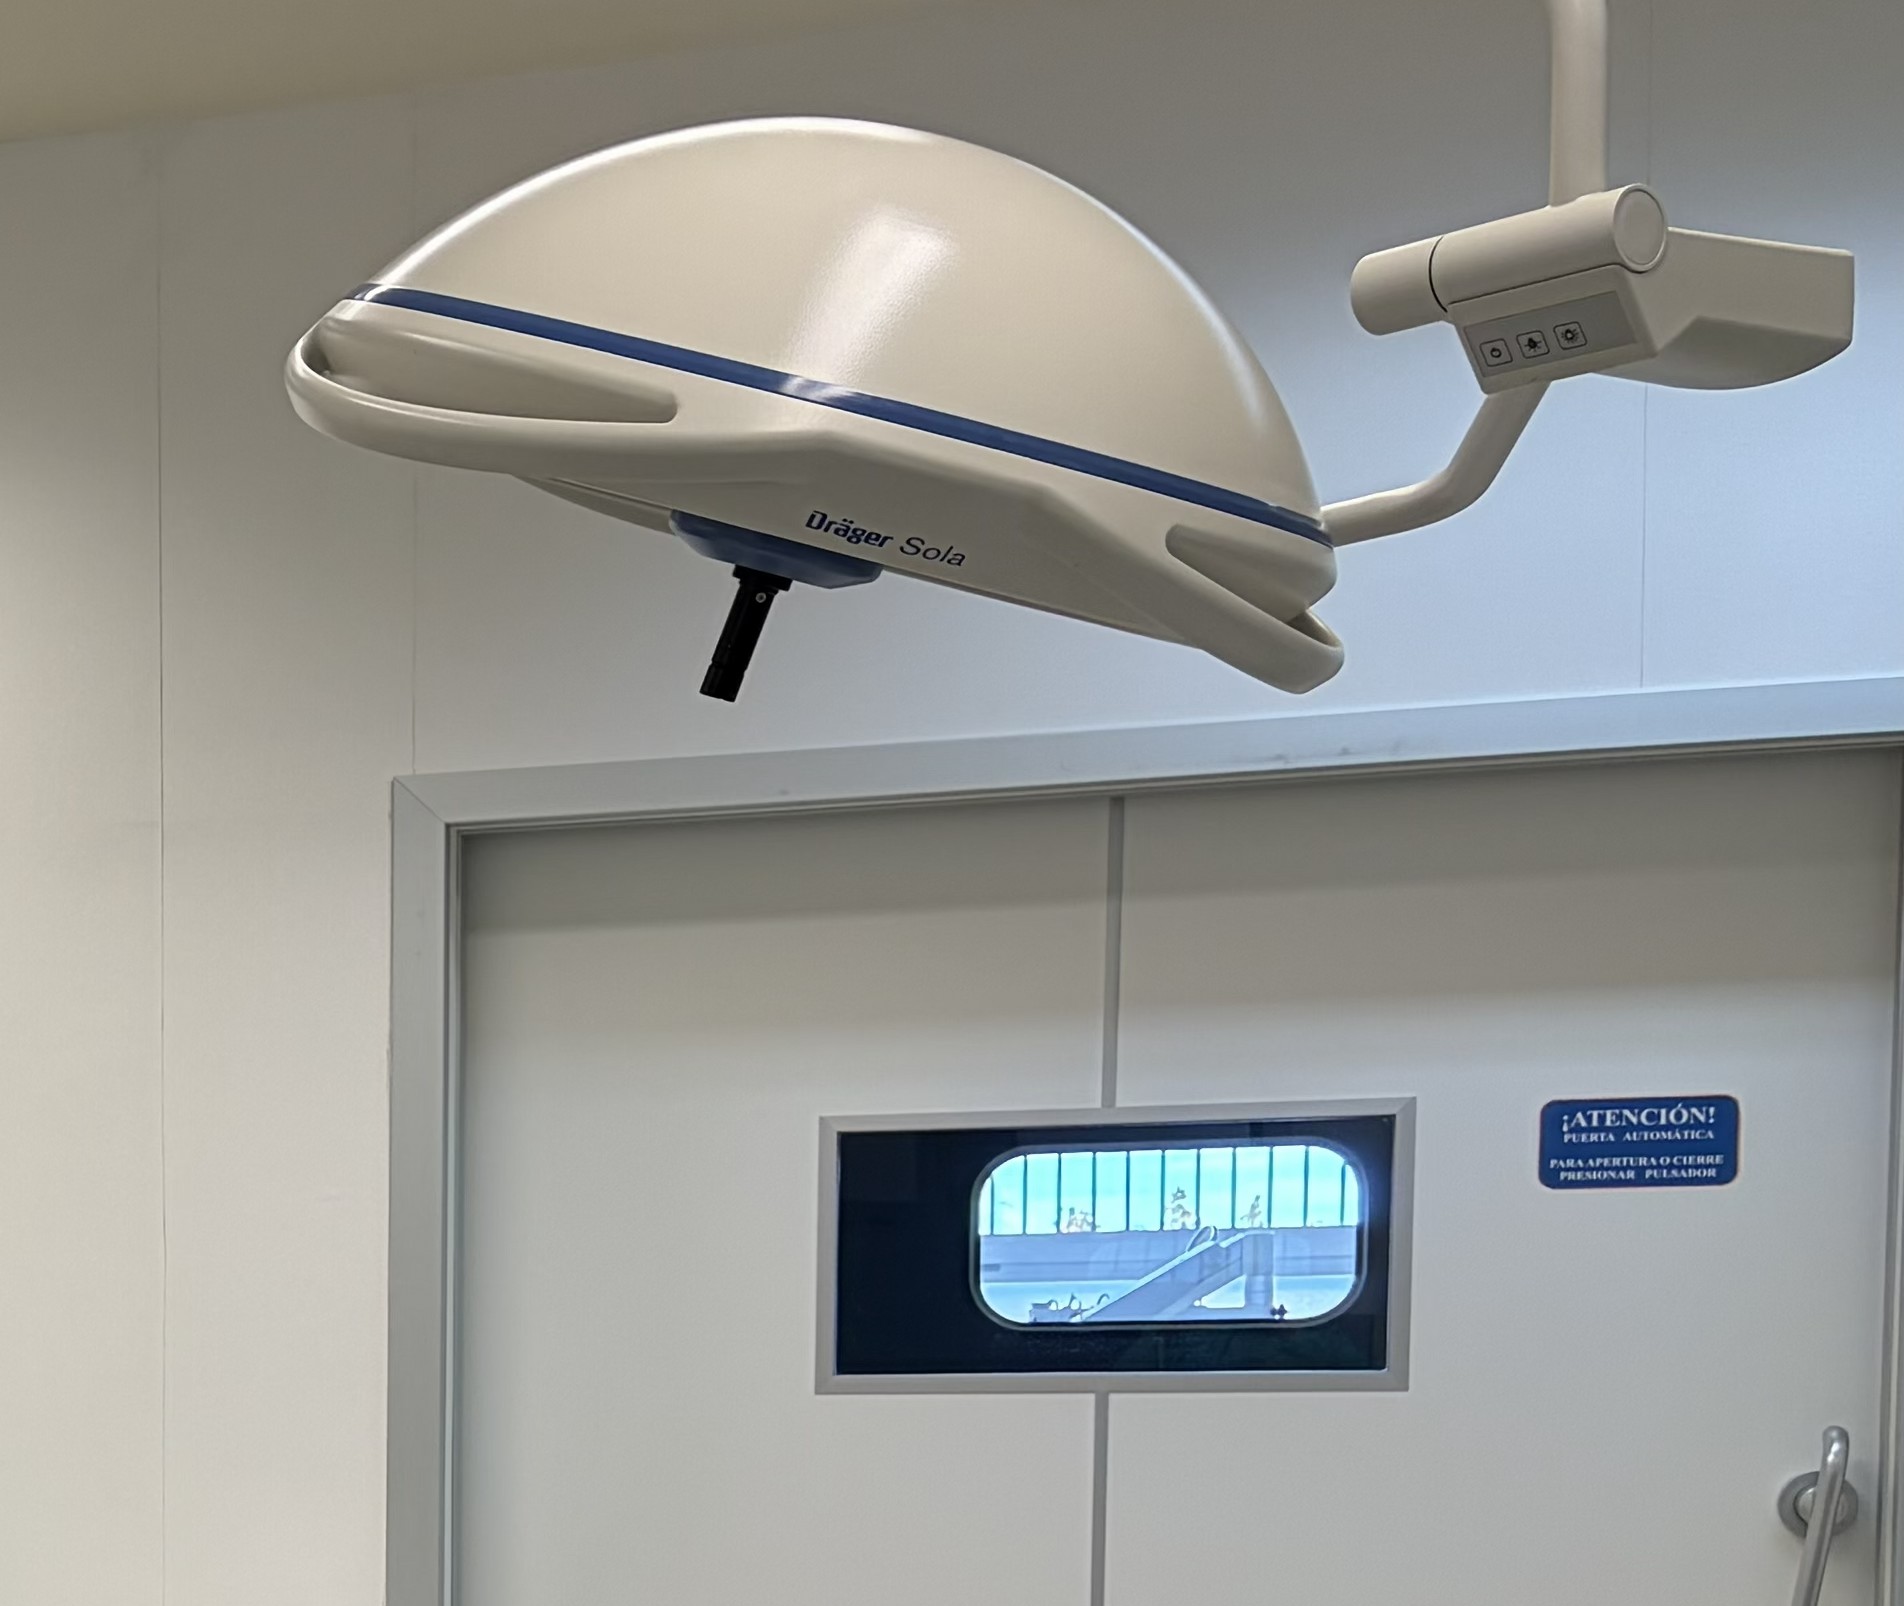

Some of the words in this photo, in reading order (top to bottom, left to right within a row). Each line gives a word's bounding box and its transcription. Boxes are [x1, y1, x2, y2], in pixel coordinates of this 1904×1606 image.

[805, 510, 894, 548] Dräger
[899, 536, 966, 567] Sola
[1562, 1103, 1716, 1132] ¡ATENCIÓN!
[1563, 1132, 1616, 1144] PUERTA
[1623, 1128, 1715, 1142] AUTOMÁTICA
[1549, 1158, 1584, 1169] PARA
[1584, 1156, 1658, 1168] APERTURA
[1659, 1155, 1671, 1166] O
[1672, 1154, 1724, 1166] CIERRE
[1559, 1170, 1636, 1181] PRESIONAR
[1644, 1167, 1717, 1179] PULSADOR
